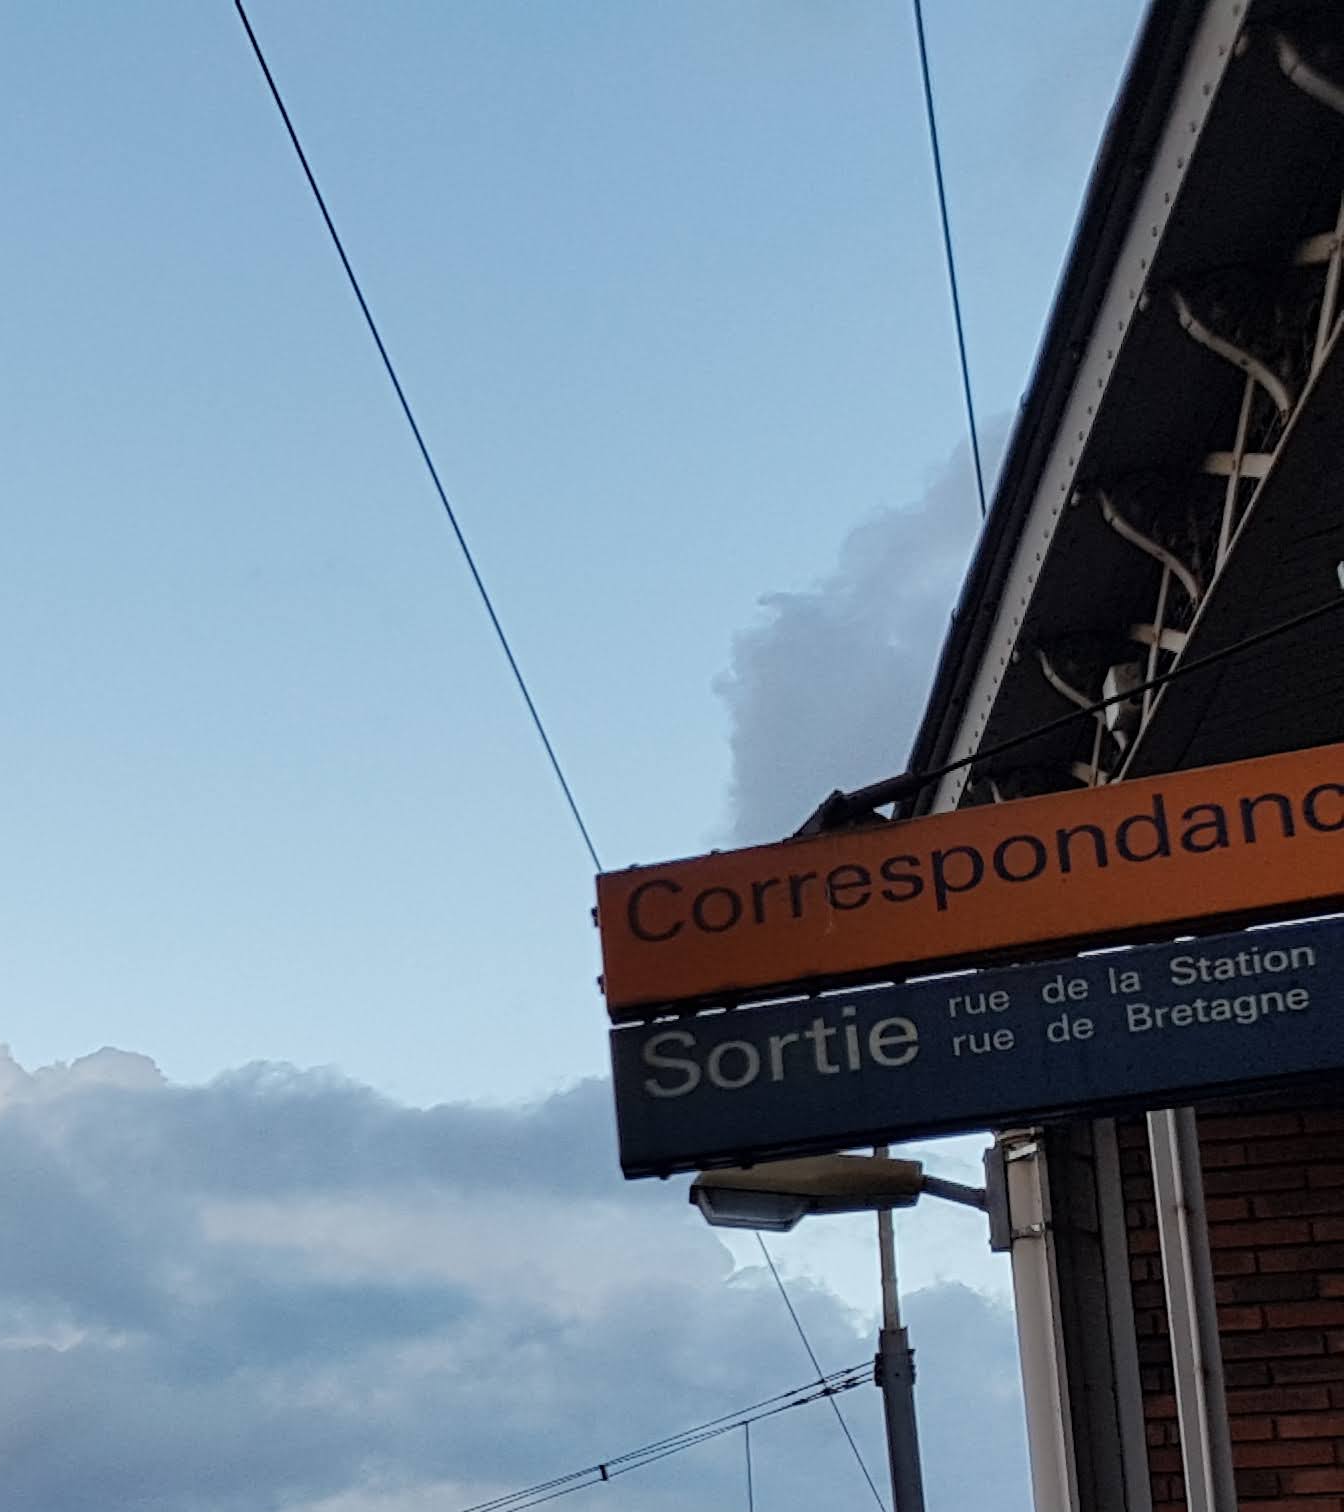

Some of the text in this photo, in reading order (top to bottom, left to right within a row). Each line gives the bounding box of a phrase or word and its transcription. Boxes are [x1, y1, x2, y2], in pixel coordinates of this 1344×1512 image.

[627, 783, 1344, 942] Correspondanc
[949, 945, 1316, 1018] rue de la Station
[953, 986, 1310, 1057] rue de Bretagne
[641, 1005, 921, 1099] Sortie
